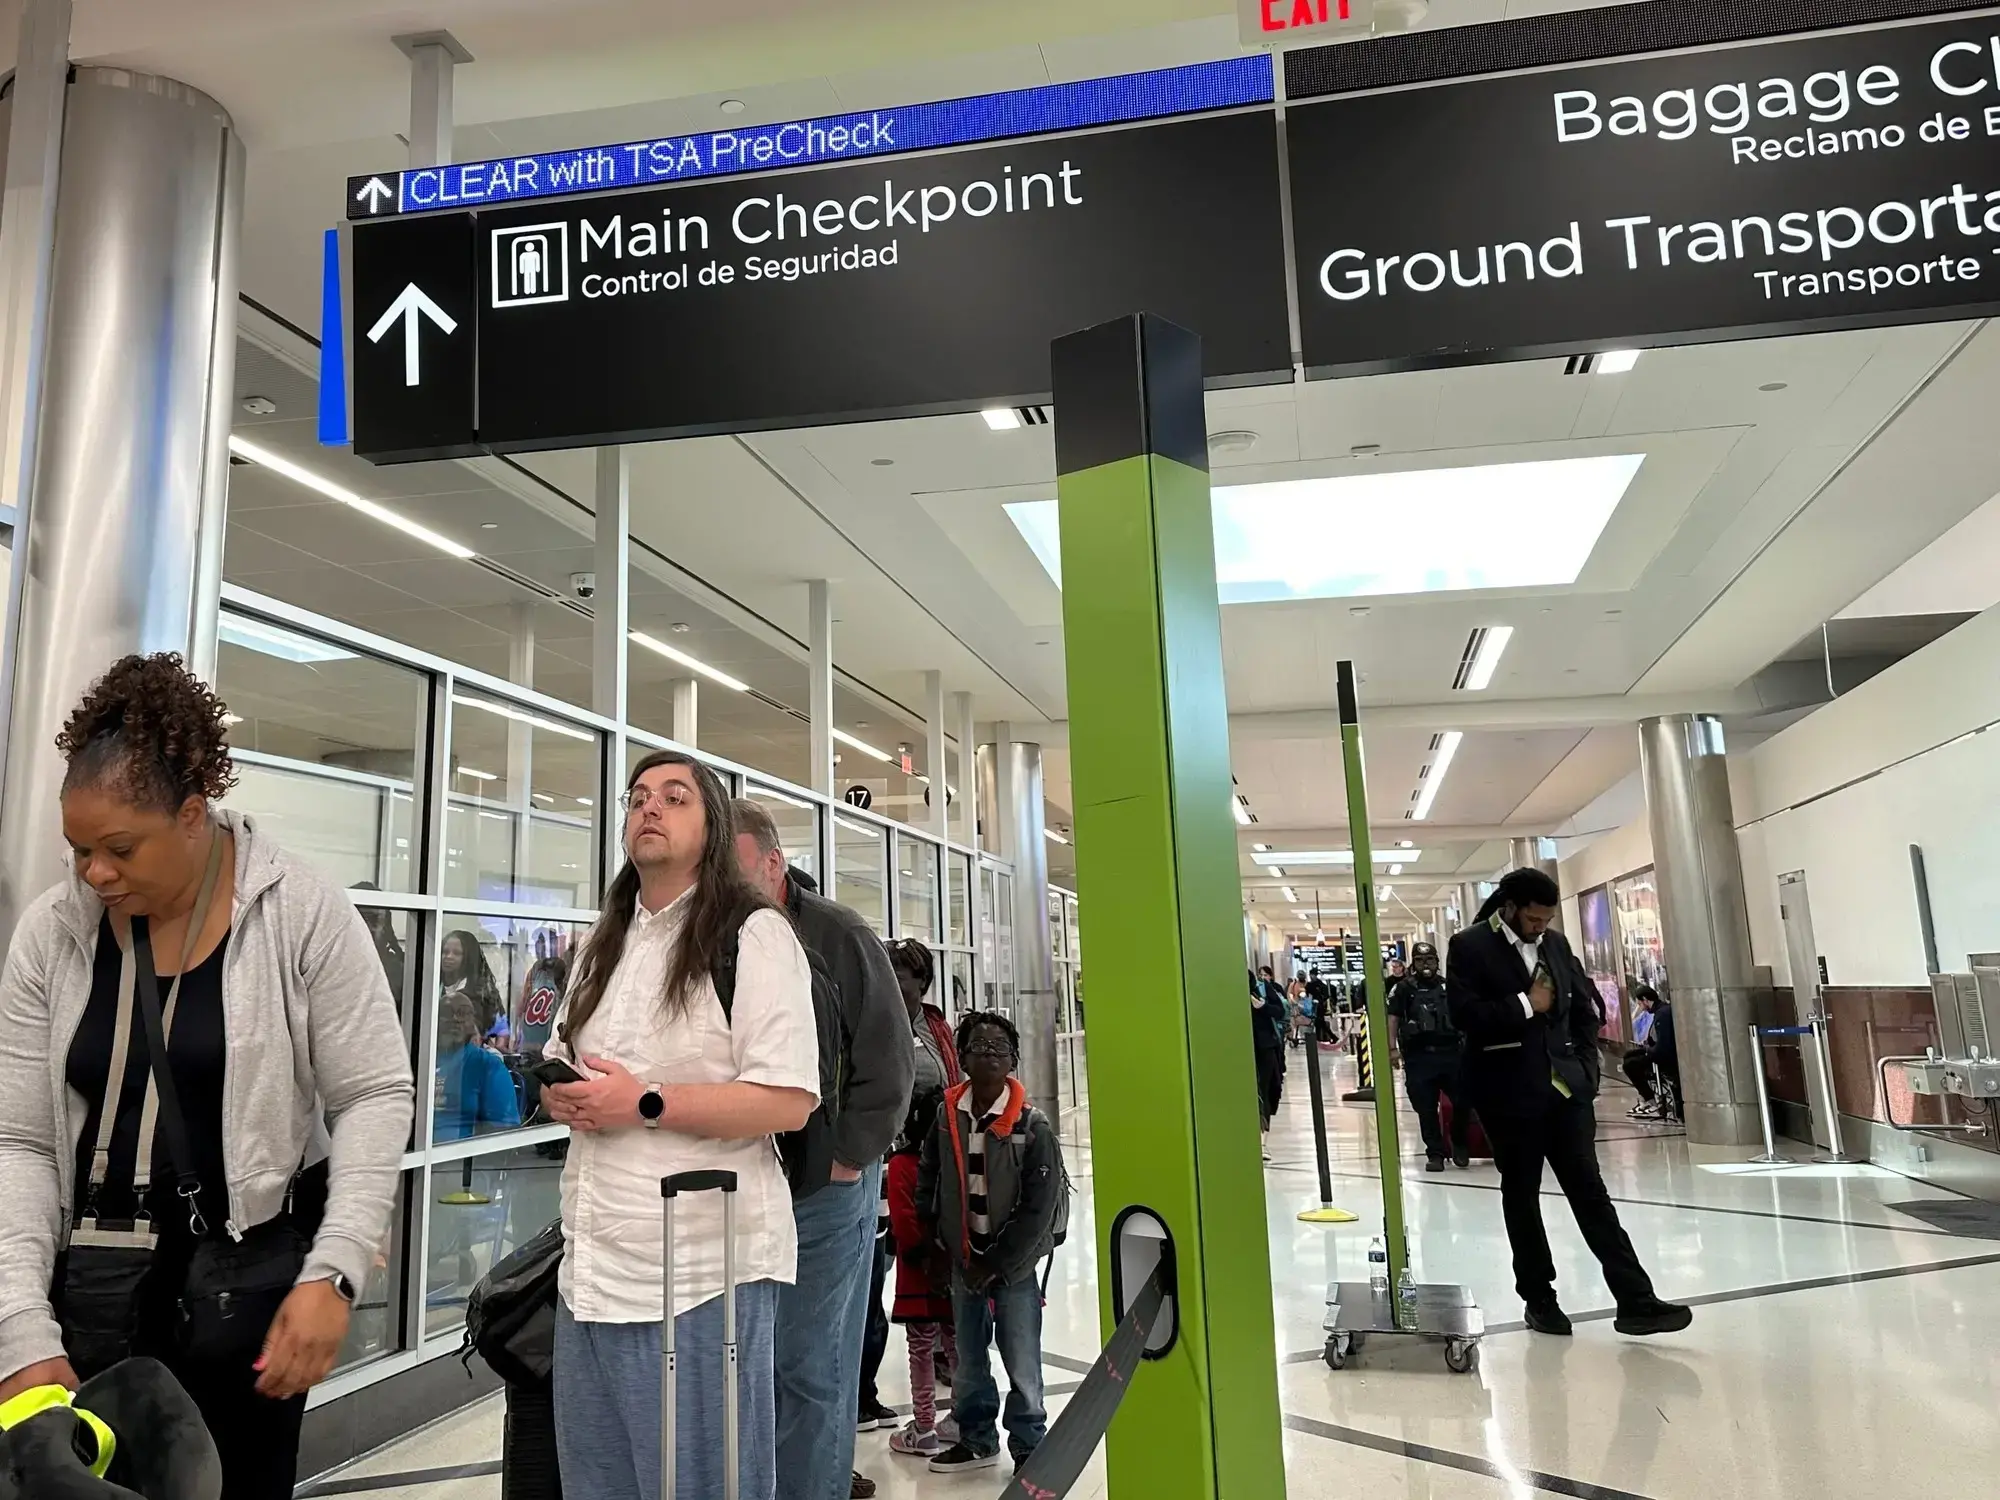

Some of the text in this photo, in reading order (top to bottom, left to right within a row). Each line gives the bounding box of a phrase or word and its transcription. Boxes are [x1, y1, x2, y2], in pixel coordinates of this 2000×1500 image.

[1554, 65, 1901, 143] Baggage
[411, 113, 895, 204] CLEAR with TSA PreCheck
[1732, 124, 1906, 165] Reclamo
[1919, 112, 1970, 143] de
[580, 160, 1083, 263] Main Checkpoint
[582, 240, 899, 299] Control de Seguridad
[1320, 221, 1584, 301] Ground
[1754, 255, 1981, 299] Transporte
[848, 790, 868, 808] 17
